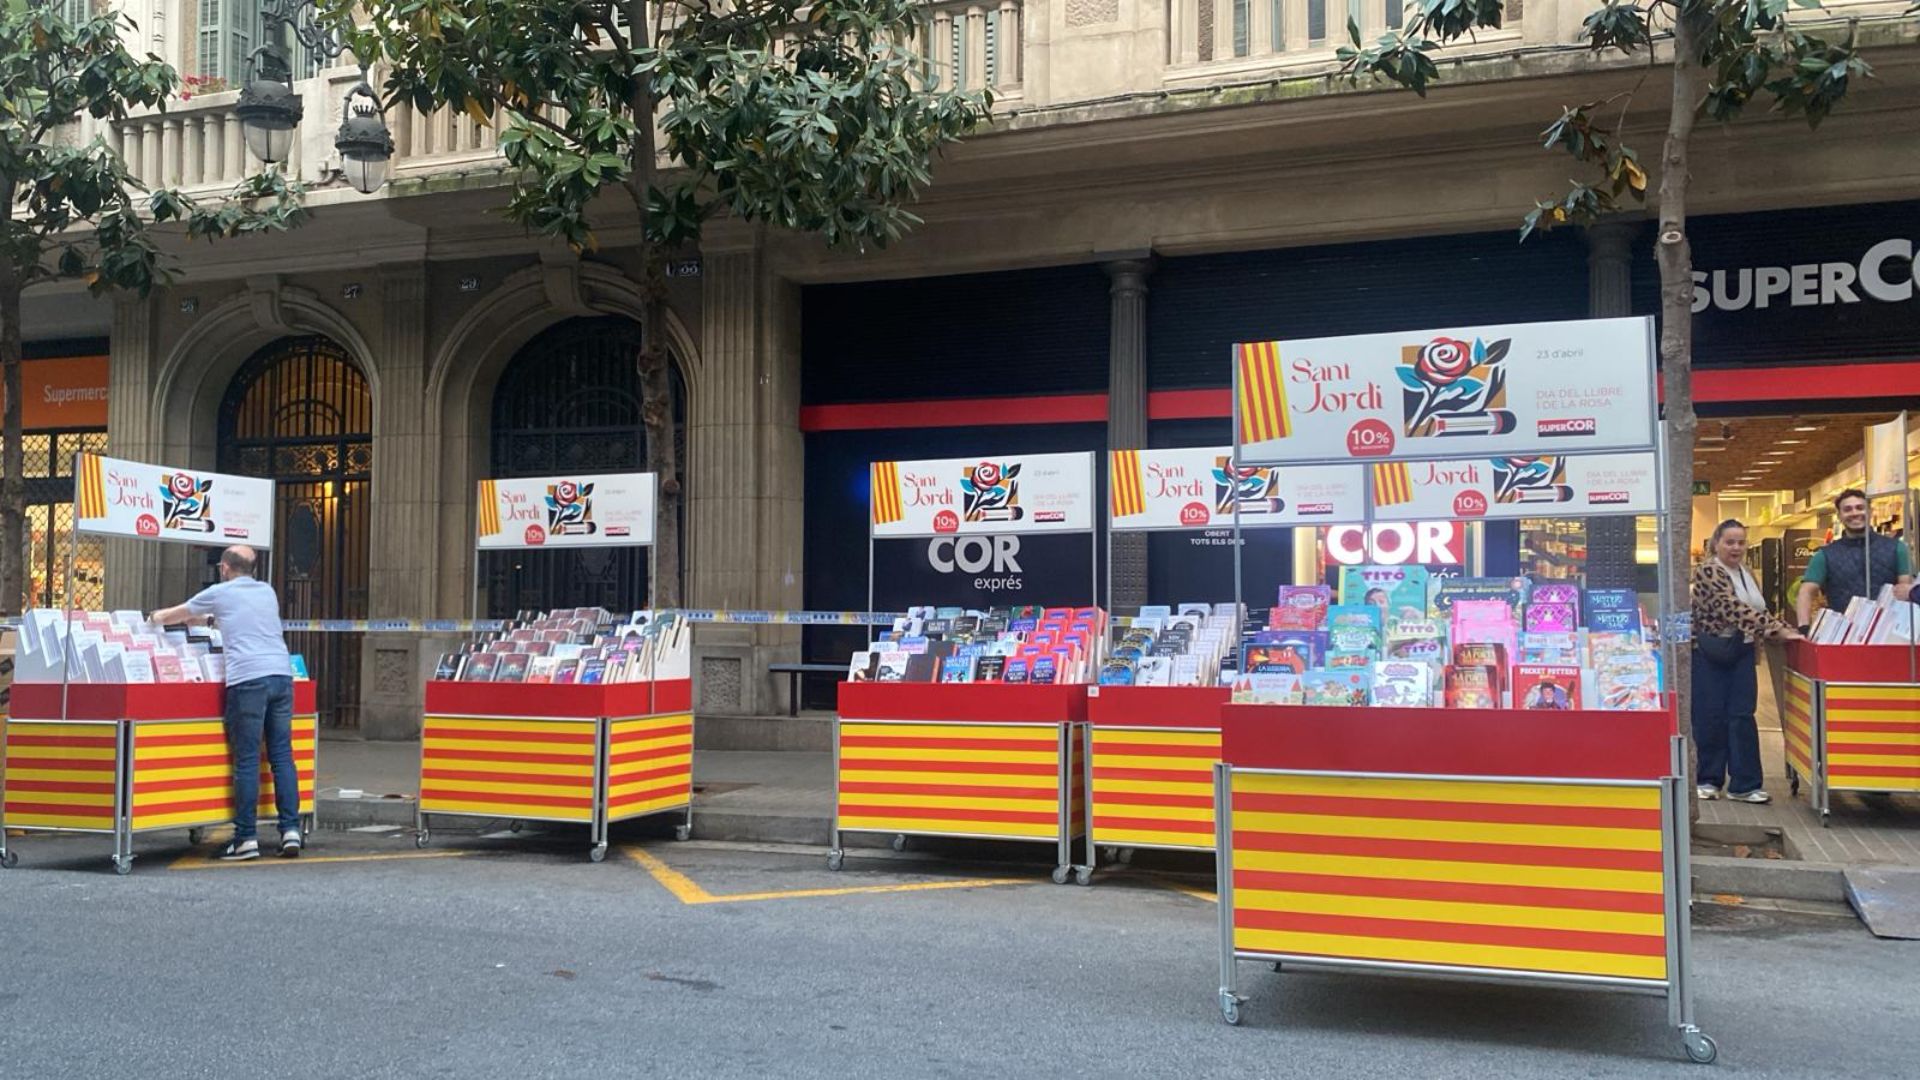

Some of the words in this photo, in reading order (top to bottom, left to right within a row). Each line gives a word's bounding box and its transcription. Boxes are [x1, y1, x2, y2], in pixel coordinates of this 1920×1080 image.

[1691, 238, 1920, 313] SUPERC
[1536, 350, 1550, 359] 23
[1551, 348, 1584, 359] d'abril
[1291, 358, 1350, 384] Sant
[1291, 381, 1383, 414] Jordi
[1536, 390, 1555, 399] DIA
[1559, 388, 1580, 398] DEL
[1584, 387, 1624, 397] LLIBRE
[1542, 401, 1559, 409] DE
[1561, 400, 1576, 408] LA
[1579, 398, 1612, 408] ROSA
[1538, 419, 1595, 433] SUPERCOR
[1351, 429, 1390, 445] 10%
[1147, 463, 1184, 478] Sant
[1413, 463, 1479, 486] Jordi
[904, 472, 936, 487] Sant
[1147, 479, 1203, 498] Jordi
[108, 487, 154, 509] Jordi
[904, 489, 953, 507] Jordi
[1456, 497, 1484, 509] 10%
[501, 504, 540, 521] Jordi
[935, 515, 957, 526] 10%
[1183, 509, 1207, 519] 10%
[1326, 521, 1458, 565] COR
[928, 535, 1023, 573] COR
[973, 575, 1023, 592] exprés
